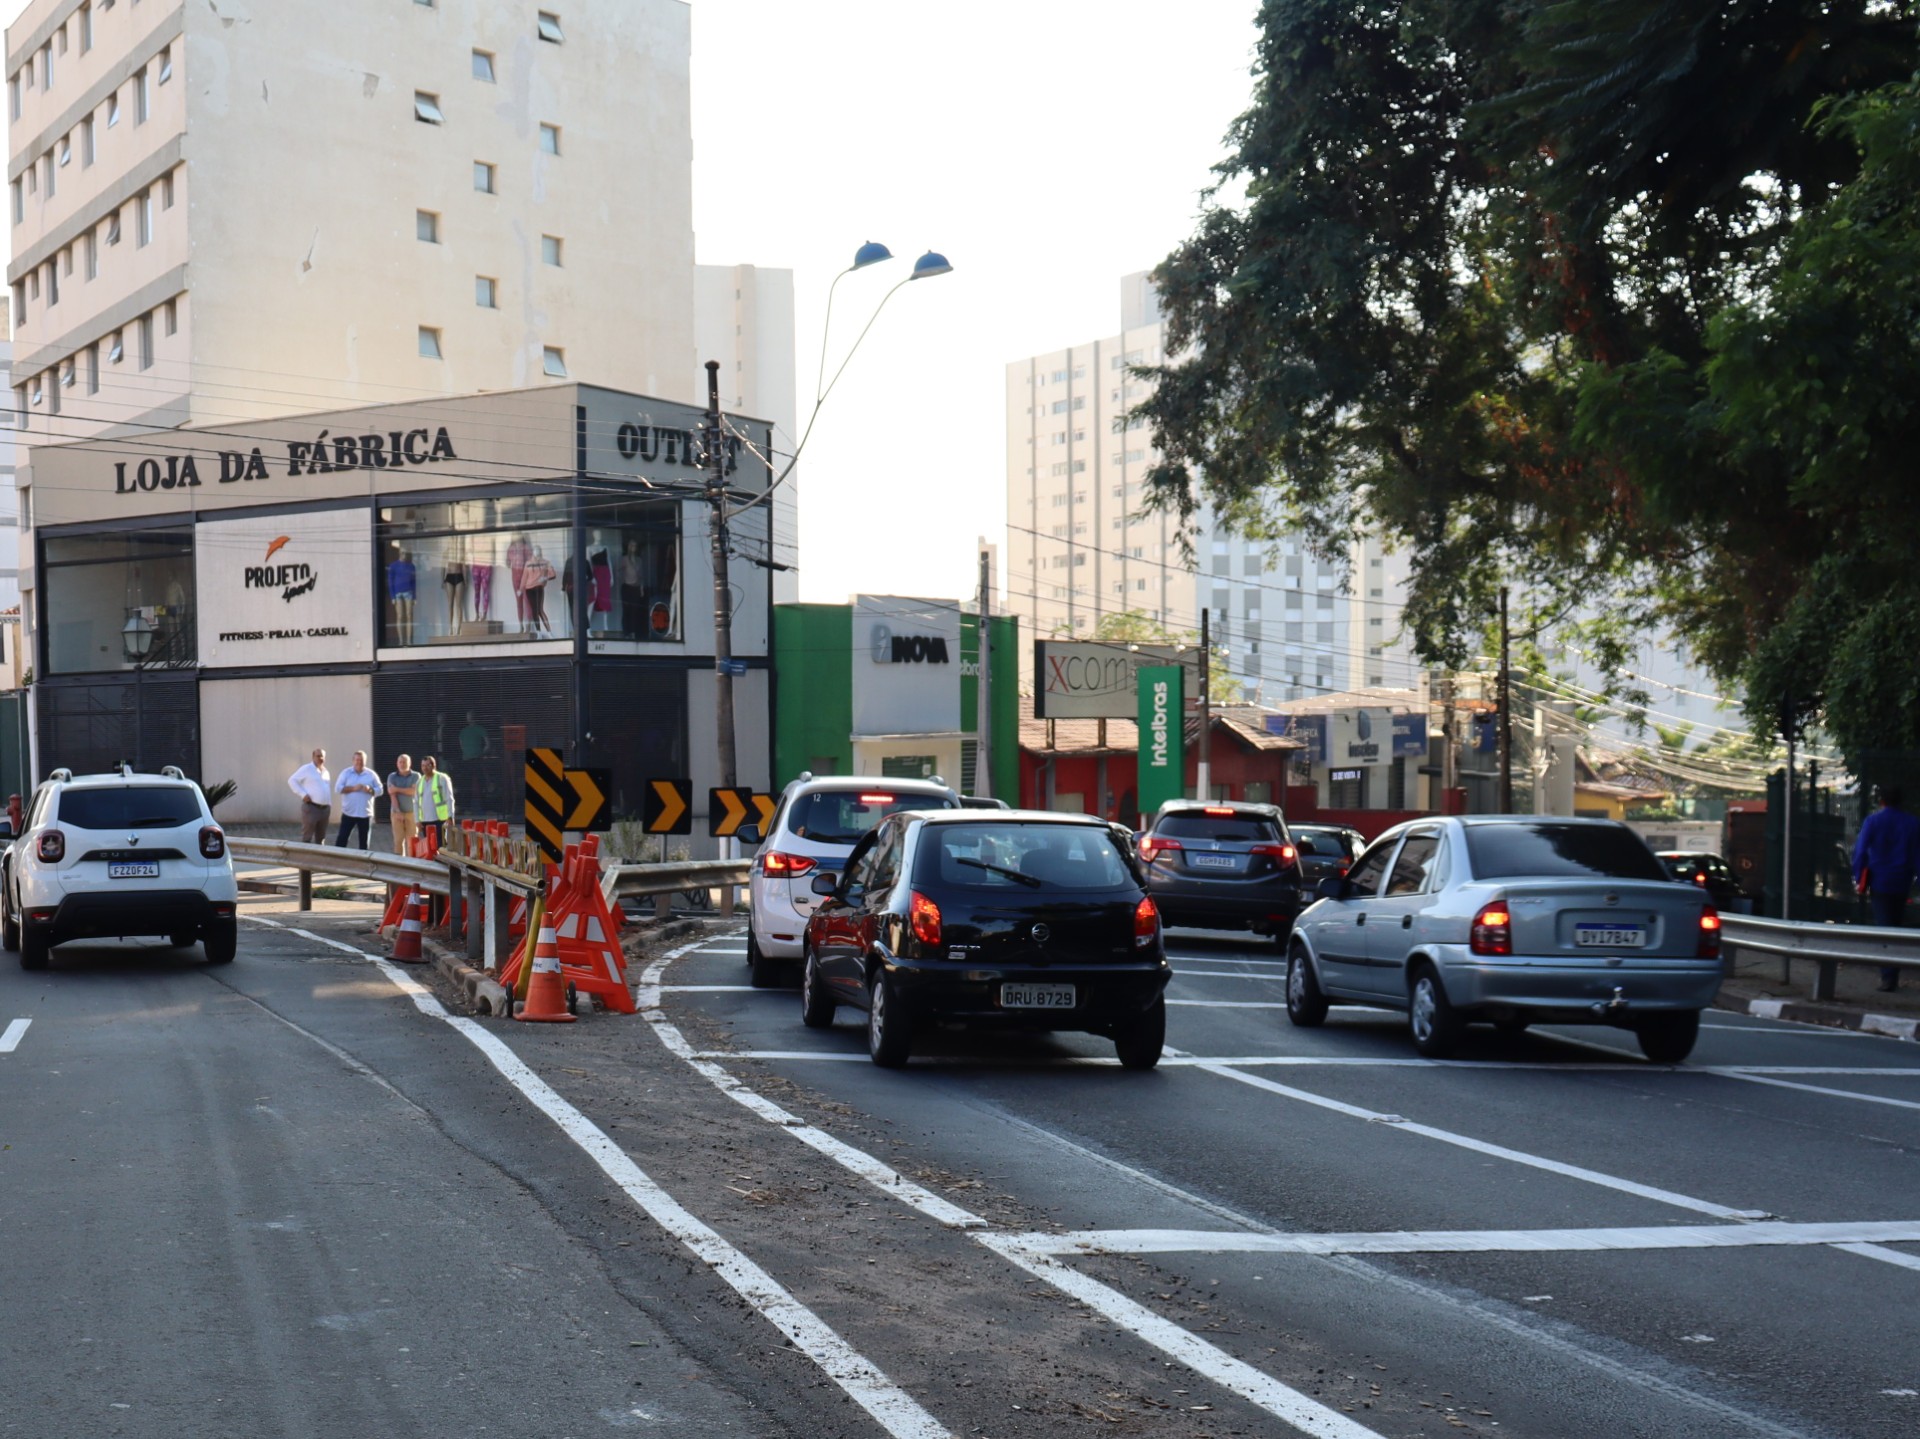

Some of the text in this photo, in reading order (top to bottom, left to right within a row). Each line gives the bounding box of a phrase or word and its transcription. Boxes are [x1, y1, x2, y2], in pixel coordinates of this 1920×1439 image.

[114, 427, 457, 494] LOJA DA FÁBRICA
[891, 635, 949, 664] INOVA
[1150, 680, 1168, 767] intelbras
[813, 793, 822, 803] 12
